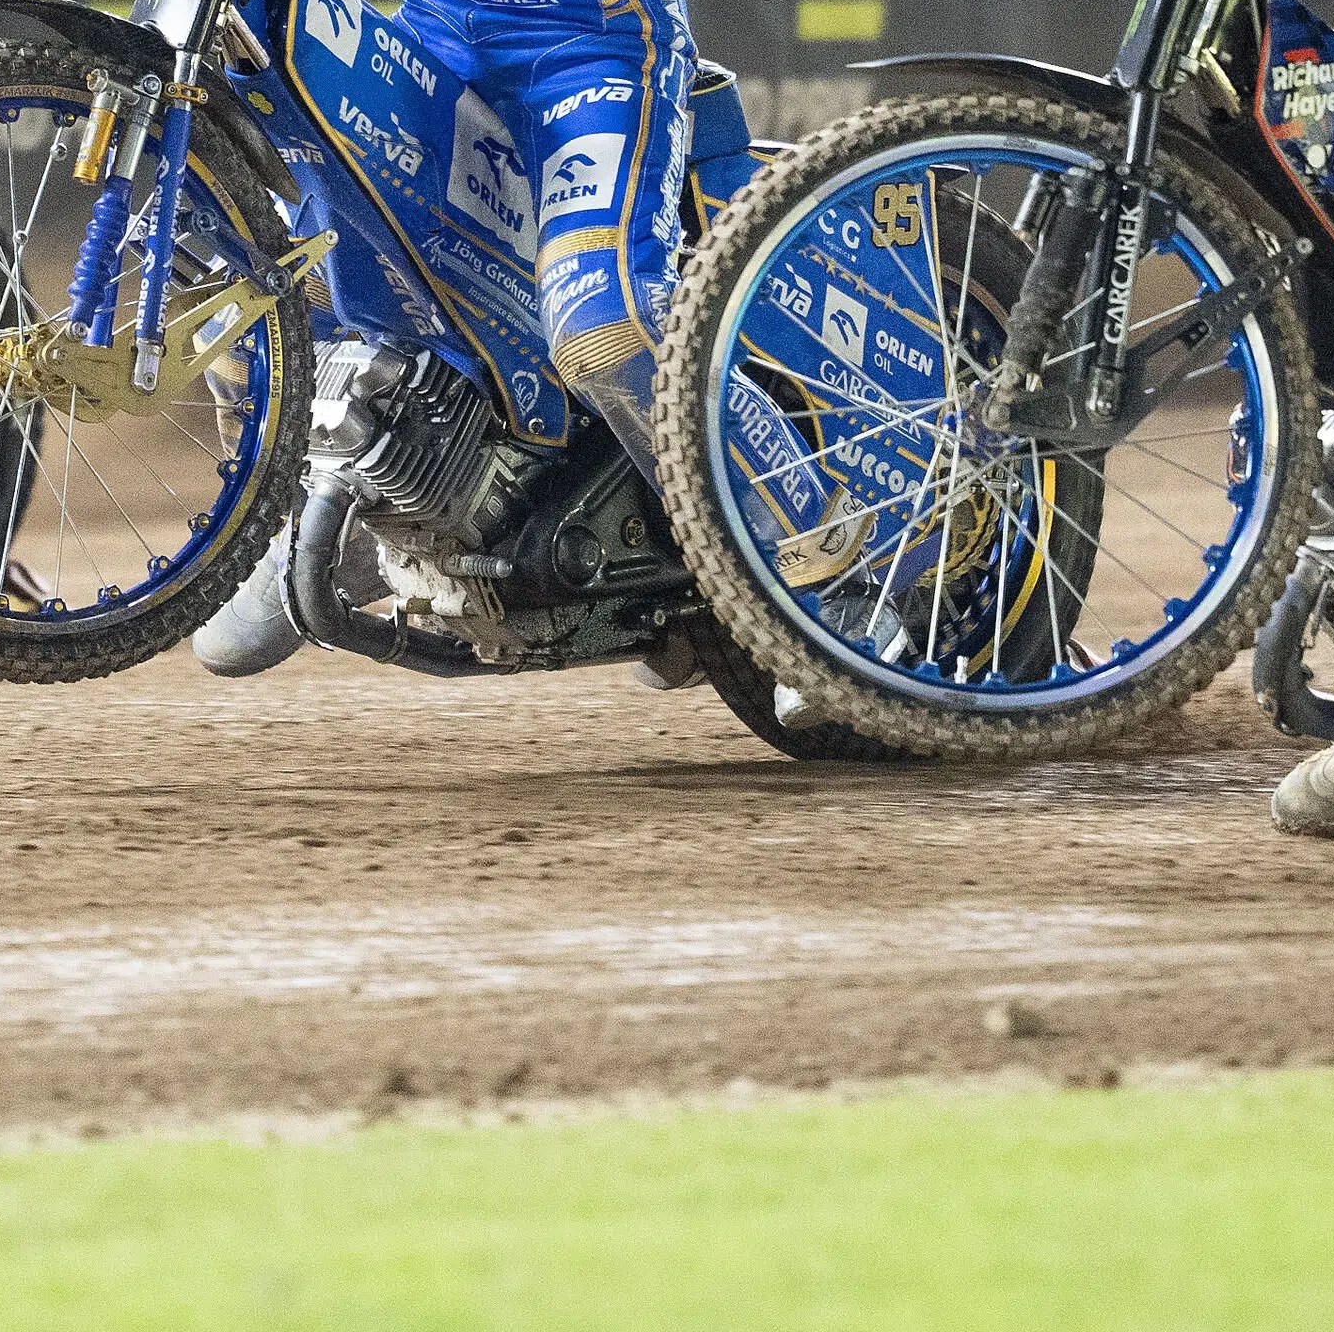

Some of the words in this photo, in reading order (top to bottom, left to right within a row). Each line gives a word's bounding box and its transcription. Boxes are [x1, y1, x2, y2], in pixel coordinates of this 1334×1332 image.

[371, 53, 395, 86] OIL
[374, 27, 437, 97] ORLEN
[543, 83, 634, 126] verva
[338, 96, 424, 177] verva
[148, 184, 164, 236] ORLEN
[467, 173, 524, 234] ORLEN
[818, 208, 861, 250] CG
[872, 183, 923, 248] 95
[544, 267, 610, 314] Team
[768, 274, 813, 318] rva
[1103, 205, 1143, 345] GARCAREK
[137, 278, 150, 330] ORLEN
[268, 309, 281, 380] ZMARZLIK
[873, 353, 894, 376] OIL
[875, 330, 934, 377] ORLEN
